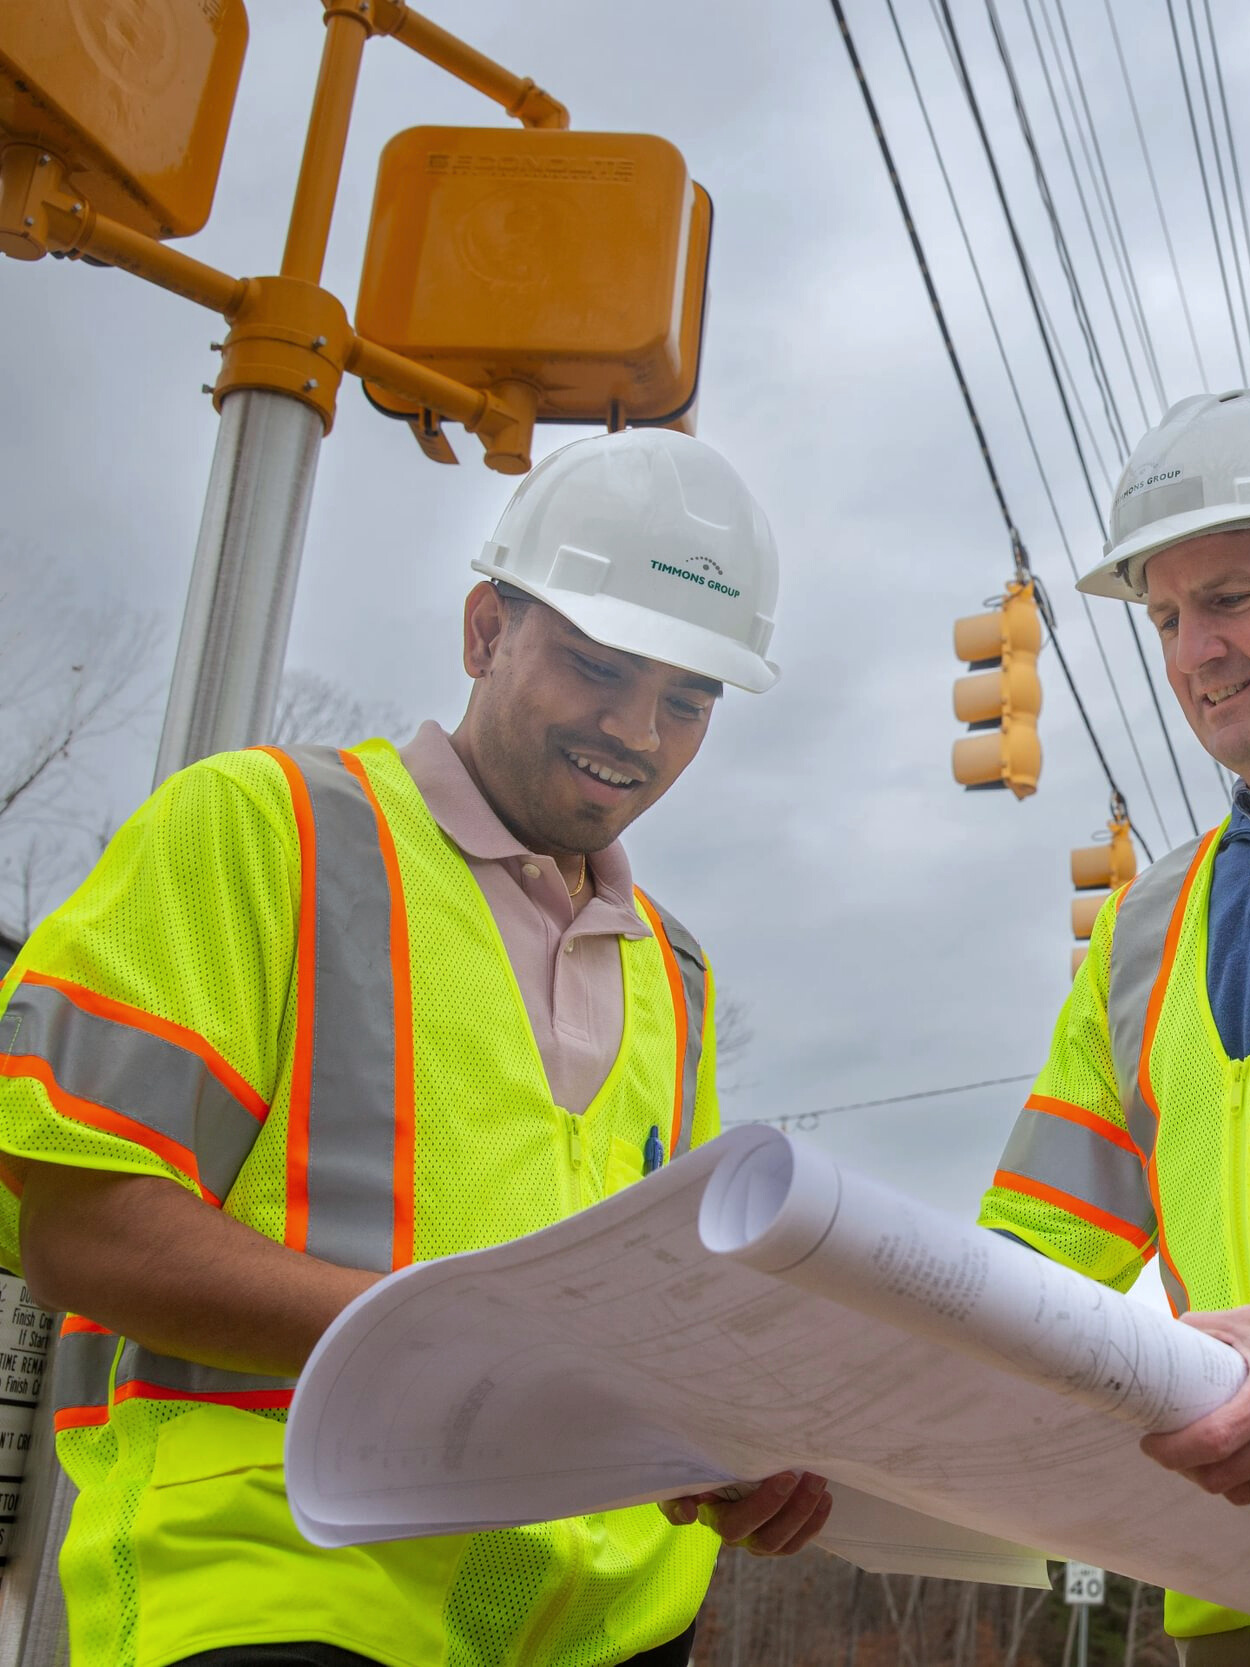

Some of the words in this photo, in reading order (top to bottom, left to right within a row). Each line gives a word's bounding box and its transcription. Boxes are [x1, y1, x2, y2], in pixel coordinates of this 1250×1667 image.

[1147, 470, 1181, 485] GROUP
[650, 559, 705, 585] TIMMONS
[707, 580, 740, 599] GROUP
[12, 1307, 35, 1327] Finish
[5, 1375, 28, 1395] Finish
[1070, 1580, 1103, 1598] 40
